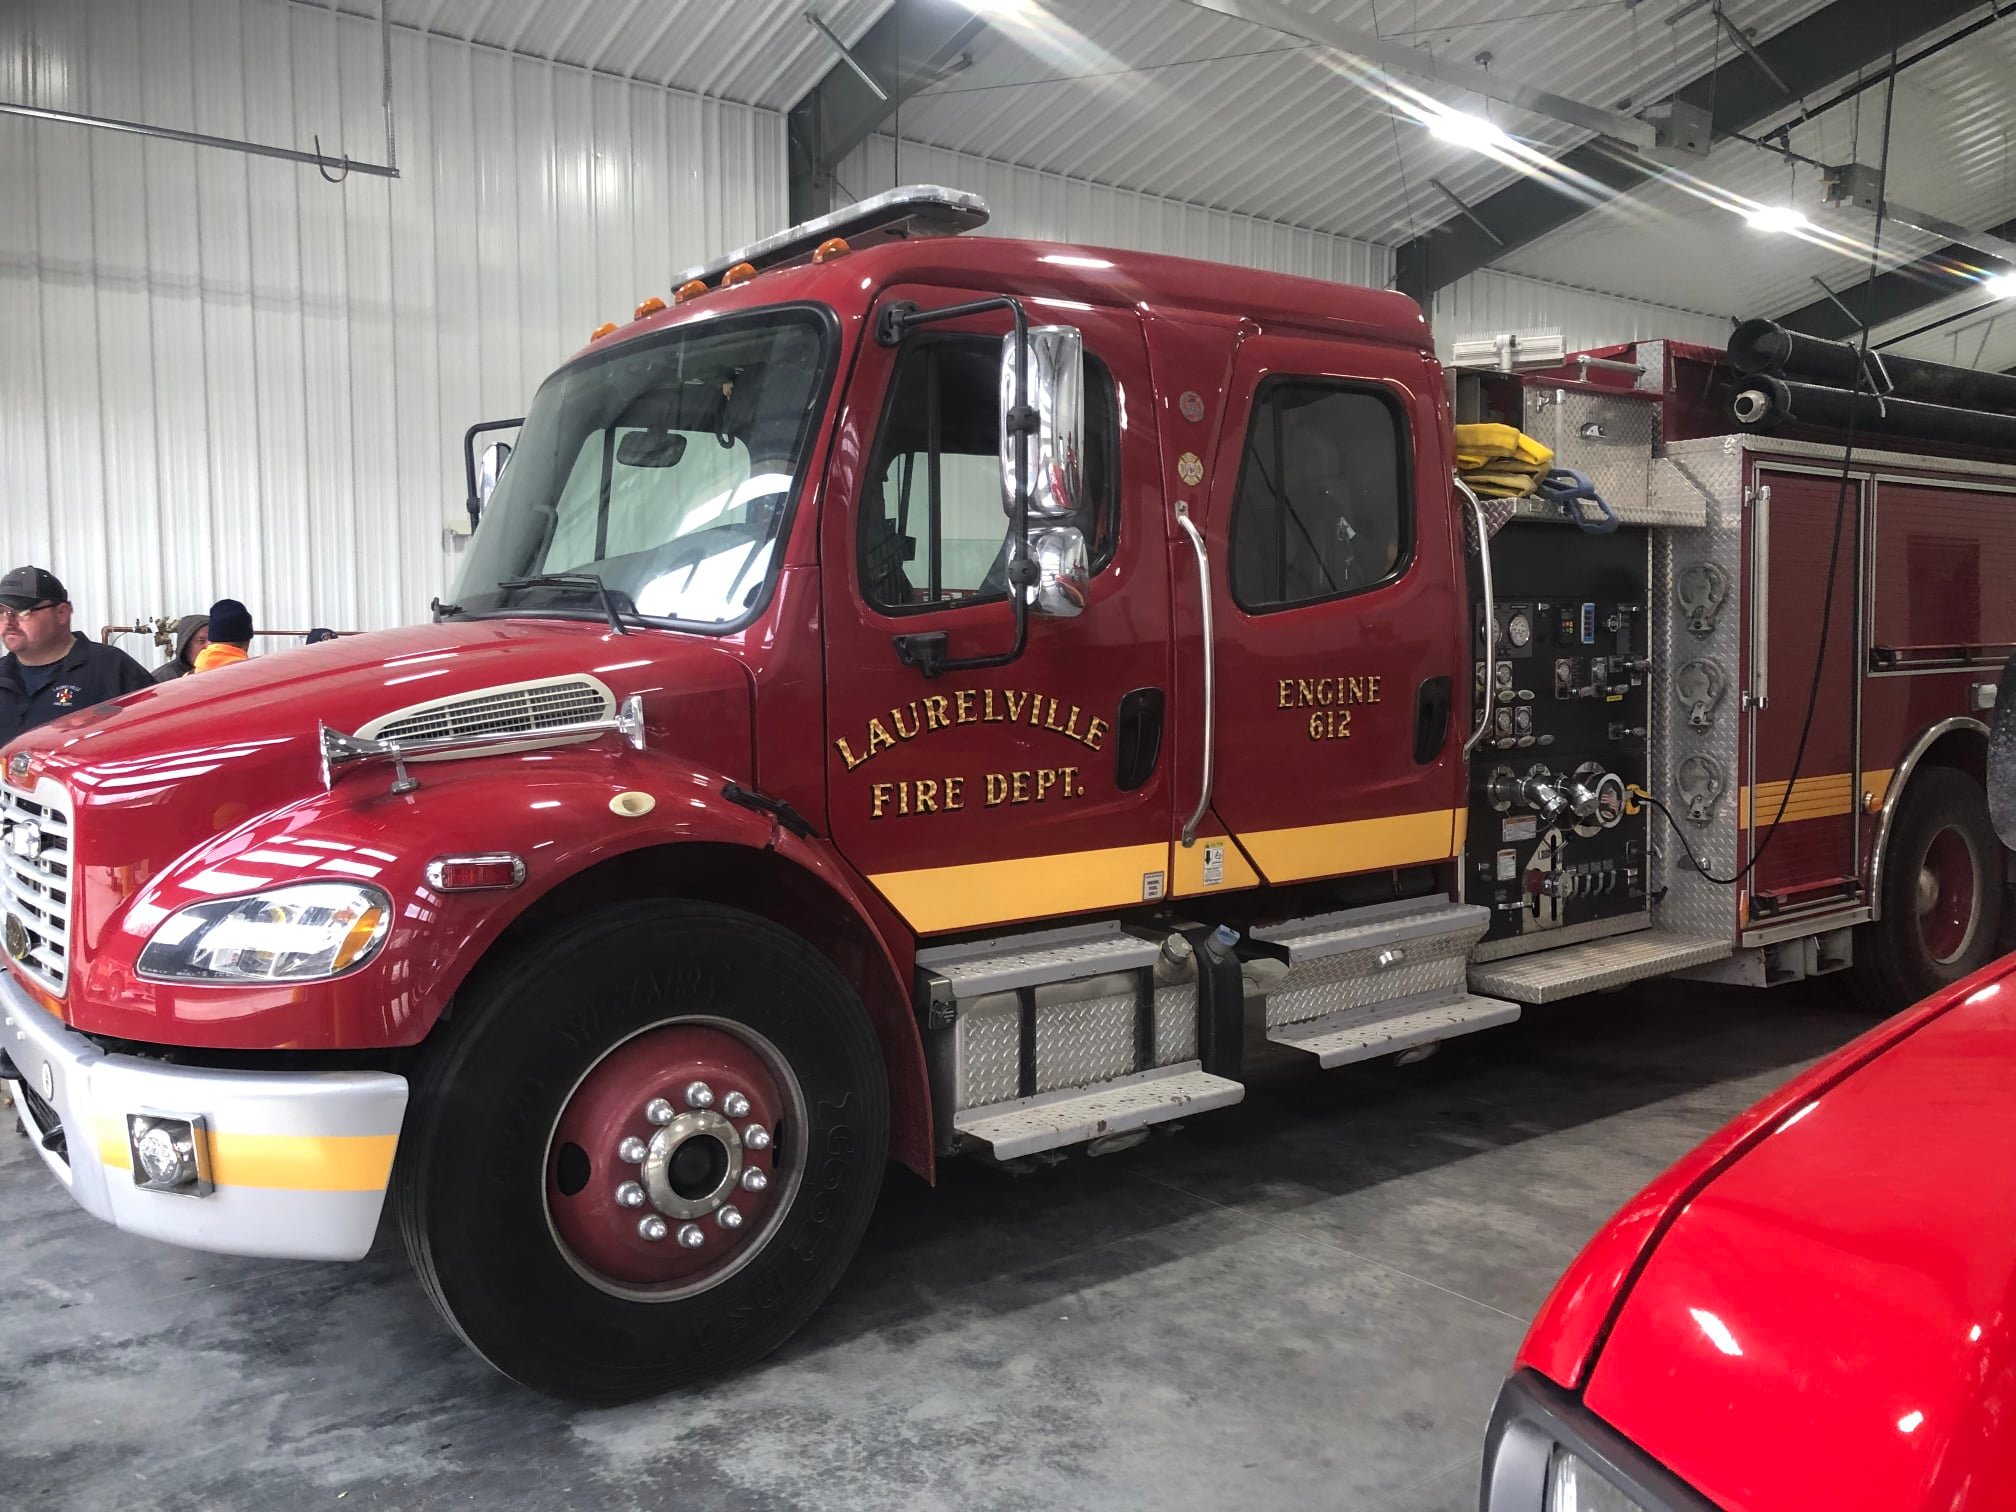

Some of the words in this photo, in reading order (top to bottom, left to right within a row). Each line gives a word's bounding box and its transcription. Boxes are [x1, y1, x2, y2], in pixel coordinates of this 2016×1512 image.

[1278, 675, 1382, 710] ENGINE
[835, 688, 1110, 770] LAURELVILLE
[1308, 709, 1352, 741] 612
[870, 776, 965, 818] FIRE
[985, 765, 1085, 809] DEPT.
